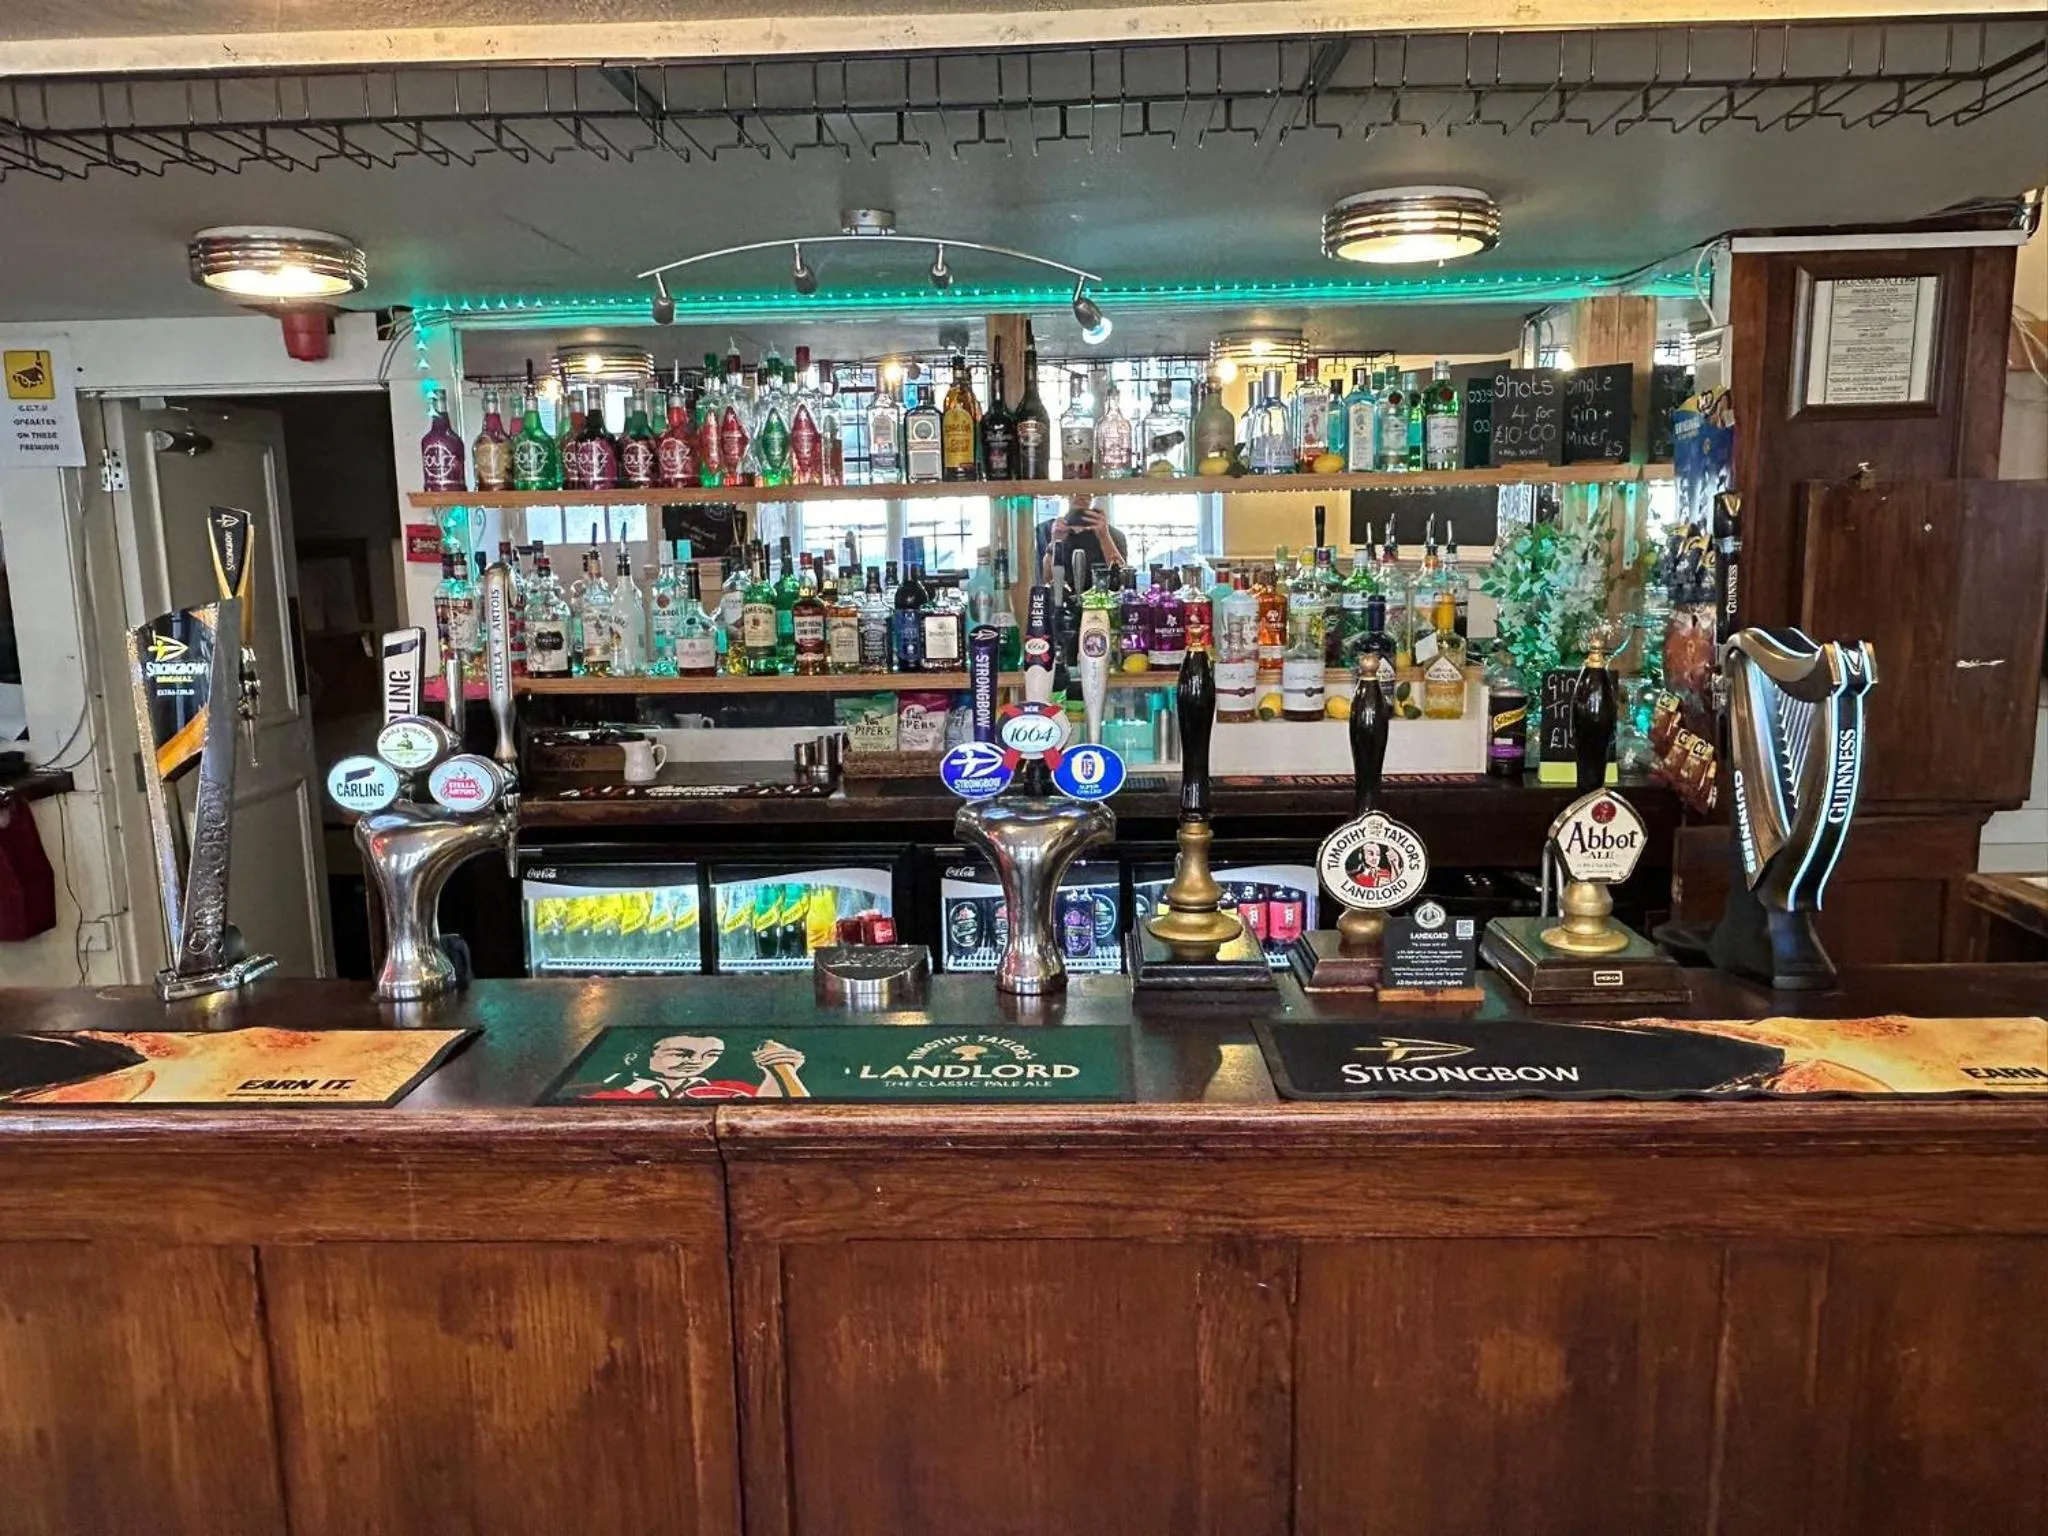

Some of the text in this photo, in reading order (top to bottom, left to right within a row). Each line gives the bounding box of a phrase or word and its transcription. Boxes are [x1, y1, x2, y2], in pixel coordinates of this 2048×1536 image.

[1494, 375, 1554, 398] Shots
[491, 588, 502, 631] ARTOIS
[975, 654, 990, 728] STRONGBOW
[1010, 726, 1053, 742] 1664
[1828, 727, 1858, 824] GUINNESS
[336, 782, 385, 798] CARLING
[1327, 827, 1420, 871] TIMOTHY TAYLOR'S
[1565, 822, 1639, 853] Abbot
[1340, 879, 1407, 900] LANDLORD
[907, 1035, 968, 1061] TIMOTHY
[860, 1064, 1080, 1079] LANDLORD
[1341, 1064, 1580, 1083] STRONGBOW
[236, 1079, 356, 1089] EARN IT.
